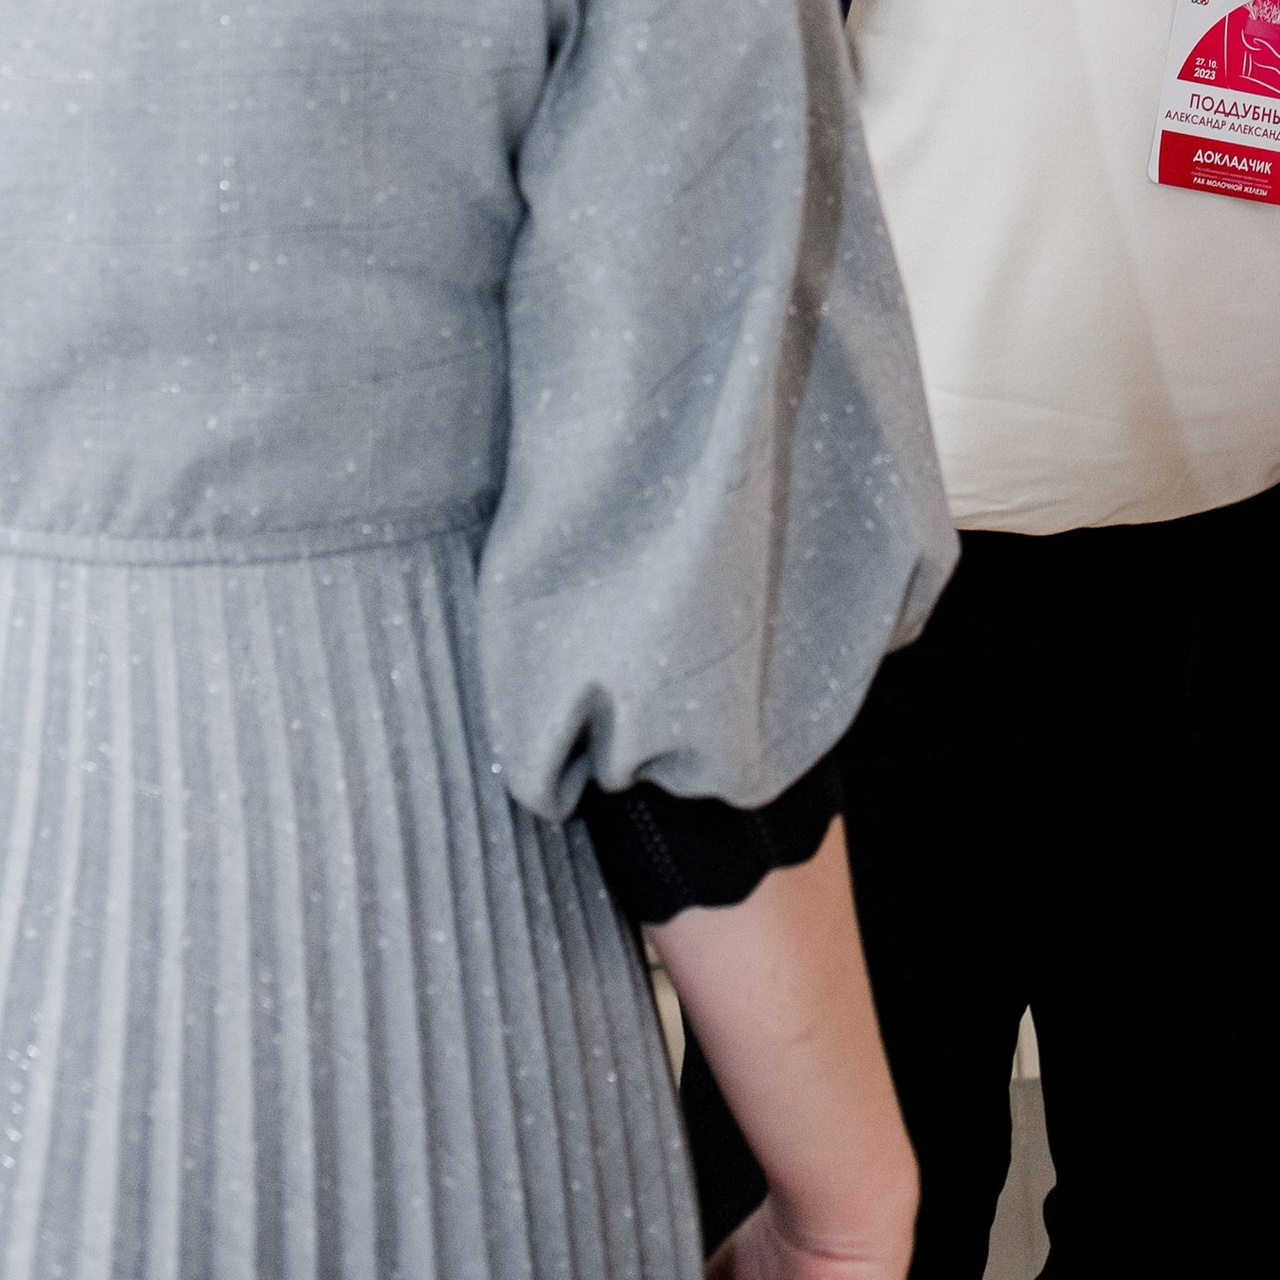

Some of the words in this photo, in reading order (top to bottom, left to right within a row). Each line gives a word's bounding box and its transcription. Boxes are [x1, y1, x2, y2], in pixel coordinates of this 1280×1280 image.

[1193, 67, 1216, 81] 2023
[1164, 109, 1227, 131] АЛЕКСАНДР
[1192, 148, 1273, 175] ДОКЛАДЧИК
[1206, 179, 1243, 192] МОЛОЧНОЙ
[1243, 186, 1268, 197] ЖЕЛЕЗЫ
